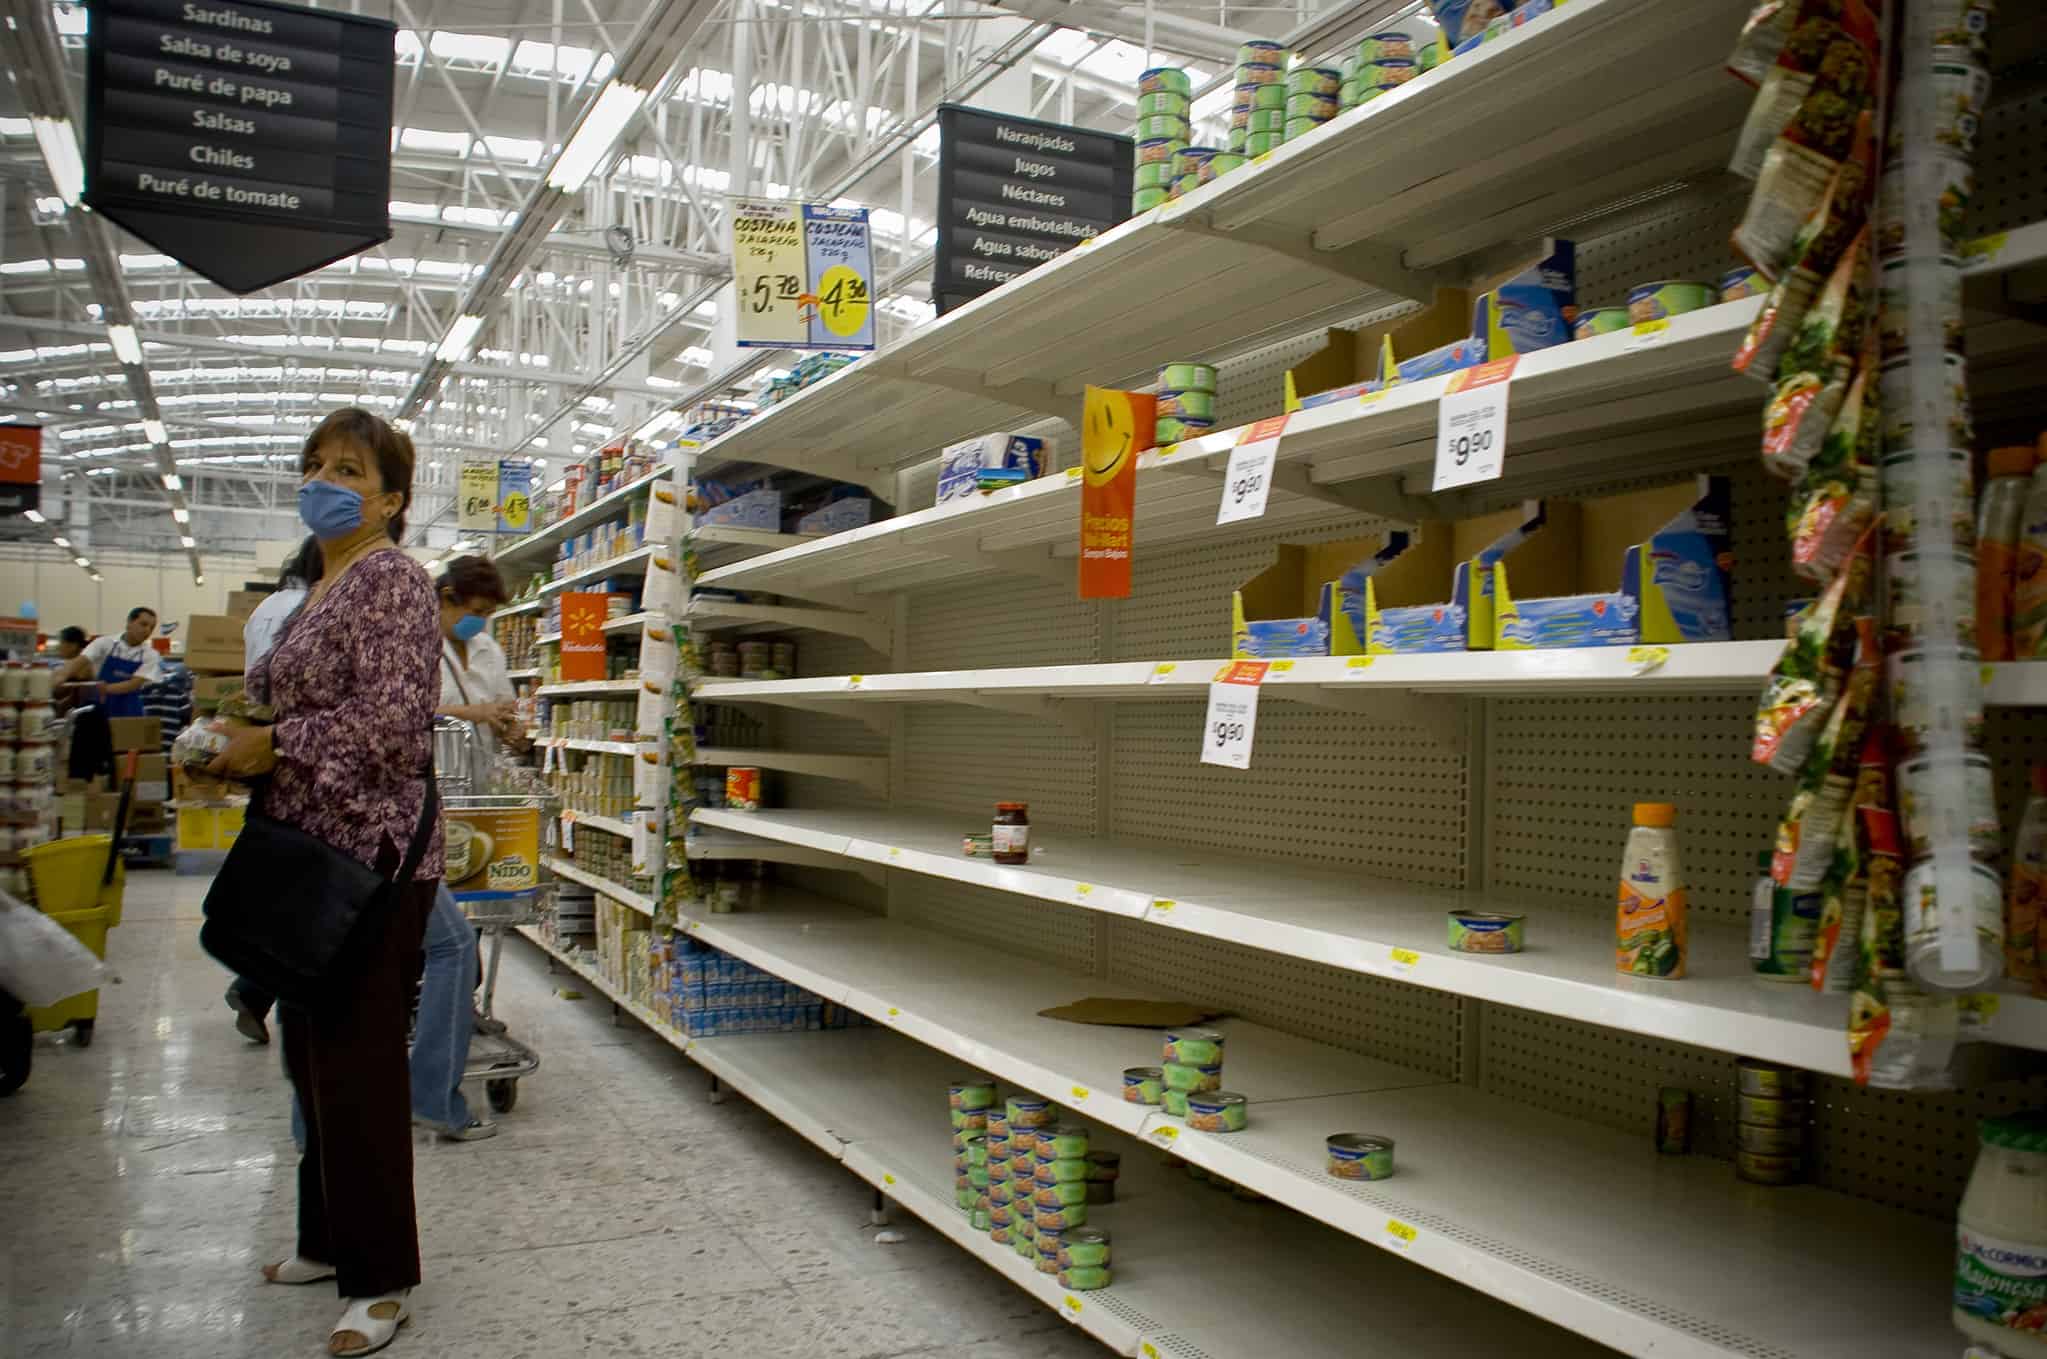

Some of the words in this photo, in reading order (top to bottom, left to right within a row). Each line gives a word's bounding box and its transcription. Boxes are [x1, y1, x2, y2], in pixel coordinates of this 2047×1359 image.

[183, 3, 273, 34] Sardinas
[159, 34, 212, 58] Salsa
[216, 44, 242, 63] de
[246, 50, 292, 73] soya
[155, 69, 205, 92] Puré
[209, 77, 236, 97] de
[241, 87, 293, 107] papa
[192, 110, 256, 135] Salsas
[996, 126, 1076, 152] Naranjadas
[189, 145, 255, 169] Chiles
[1014, 157, 1057, 177] Jugos
[138, 173, 189, 196] Puré
[193, 181, 221, 201] de
[225, 185, 301, 210] tomate
[1002, 183, 1066, 207] Néctares
[965, 207, 1006, 227] Agua
[1007, 215, 1100, 239] embotellada
[972, 237, 1012, 256] Agua
[1015, 244, 1066, 260] sabori
[965, 264, 1019, 282] Refres
